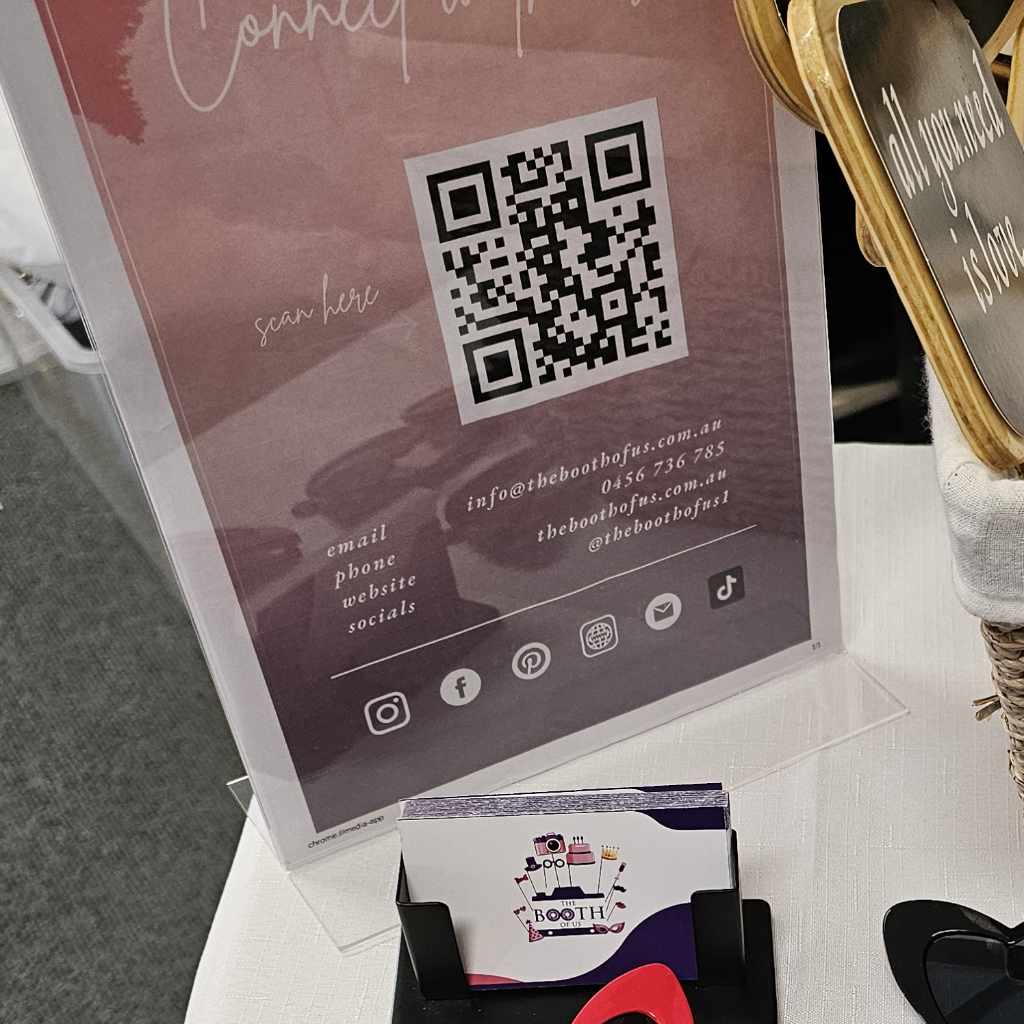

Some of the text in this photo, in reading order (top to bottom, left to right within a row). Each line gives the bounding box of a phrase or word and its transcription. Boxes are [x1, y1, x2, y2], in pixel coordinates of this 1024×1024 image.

[881, 83, 931, 199] all
[950, 228, 993, 313] is
[254, 273, 380, 347] scan here
[467, 417, 722, 512] info@theboothofus.com.au
[601, 441, 726, 495] 0456 736 785
[537, 467, 727, 543] theboothofus.com.au
[588, 490, 729, 552] @theboothofus1
[327, 524, 387, 558] email
[335, 554, 396, 590] phone
[342, 575, 416, 609] website
[348, 600, 416, 634] socials
[534, 905, 606, 922] BOOTH
